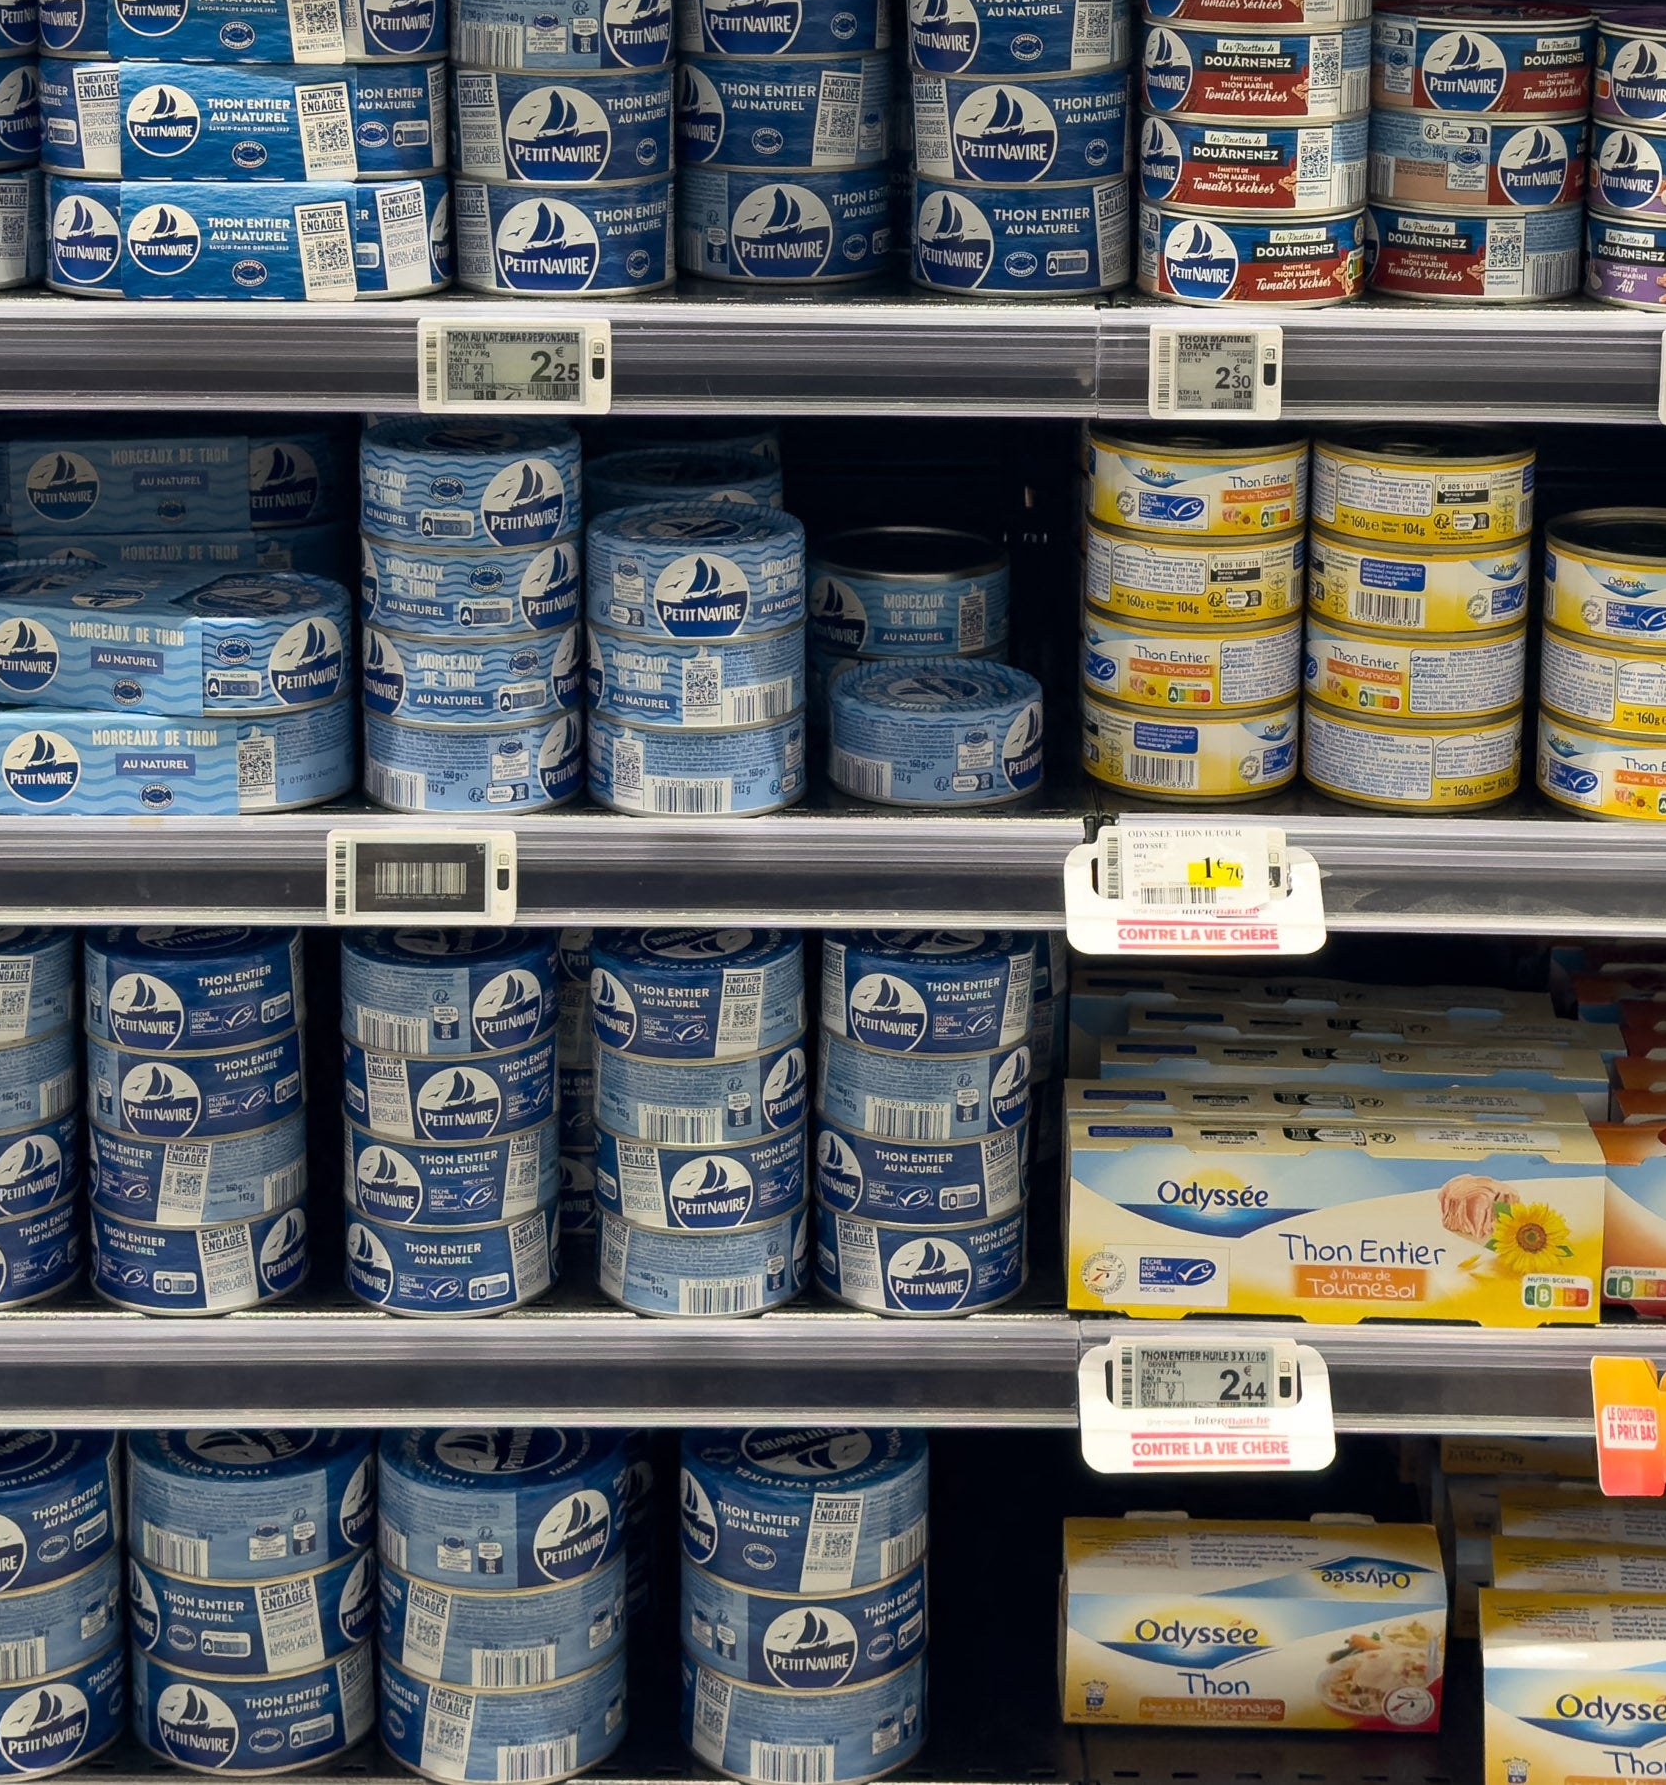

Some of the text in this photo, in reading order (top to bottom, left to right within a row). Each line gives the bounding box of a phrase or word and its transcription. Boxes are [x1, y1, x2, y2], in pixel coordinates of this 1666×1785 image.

[1158, 1180, 1269, 1209] Odyssée
[1280, 1234, 1444, 1268] Thon Entier
[1308, 1279, 1416, 1299] Tournesol
[1136, 1620, 1257, 1646] Odyssée
[1177, 1673, 1250, 1695] Thon
